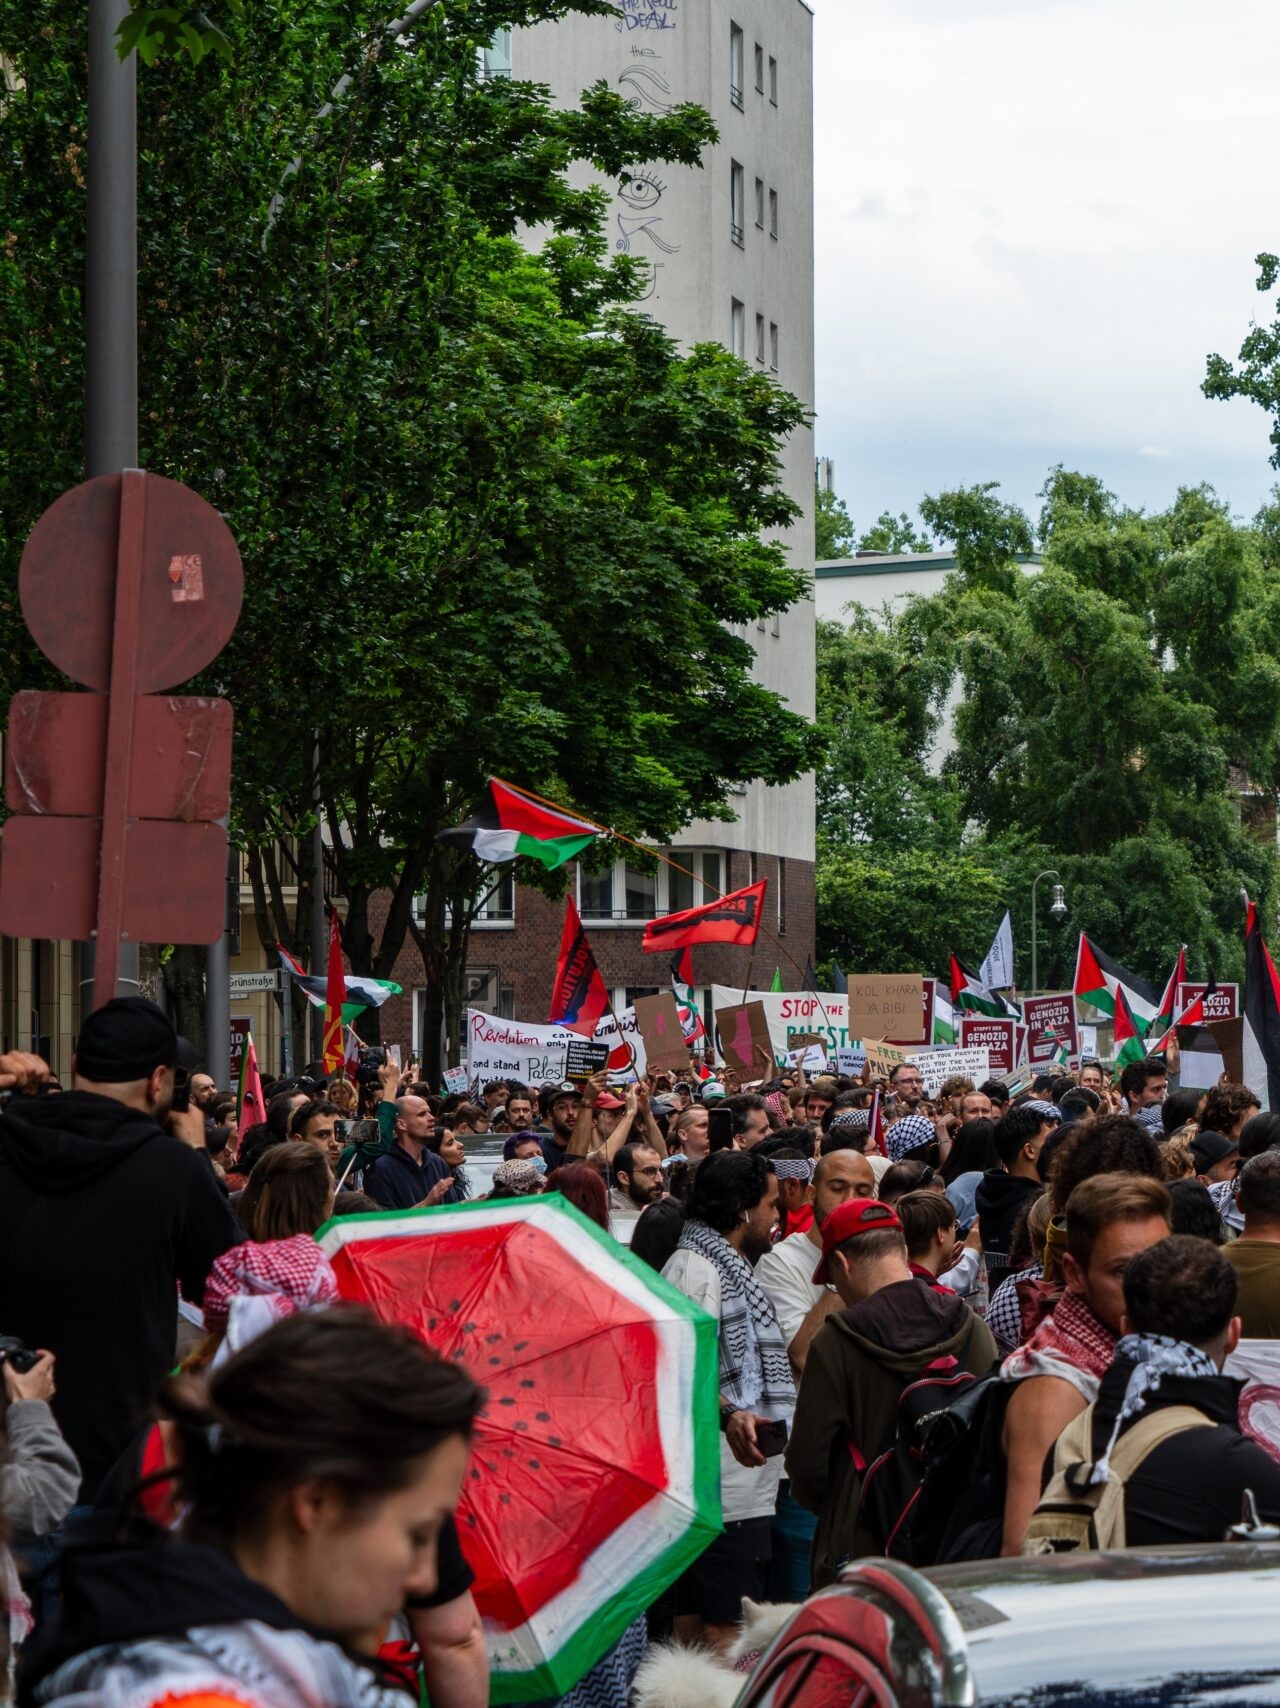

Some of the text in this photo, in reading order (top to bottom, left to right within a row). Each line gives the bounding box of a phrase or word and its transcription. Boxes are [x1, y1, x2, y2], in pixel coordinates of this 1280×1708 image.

[1188, 997, 1231, 1007] GOZID
[780, 1000, 843, 1018] STOP THE
[1030, 1006, 1070, 1020] GENOZID
[472, 1015, 540, 1045] Revolution
[1031, 1021, 1041, 1030] IN
[967, 1032, 1008, 1042] GENOZID
[877, 1047, 903, 1060] FREE
[526, 1056, 567, 1082] Palest
[921, 1068, 946, 1076] RMANY
